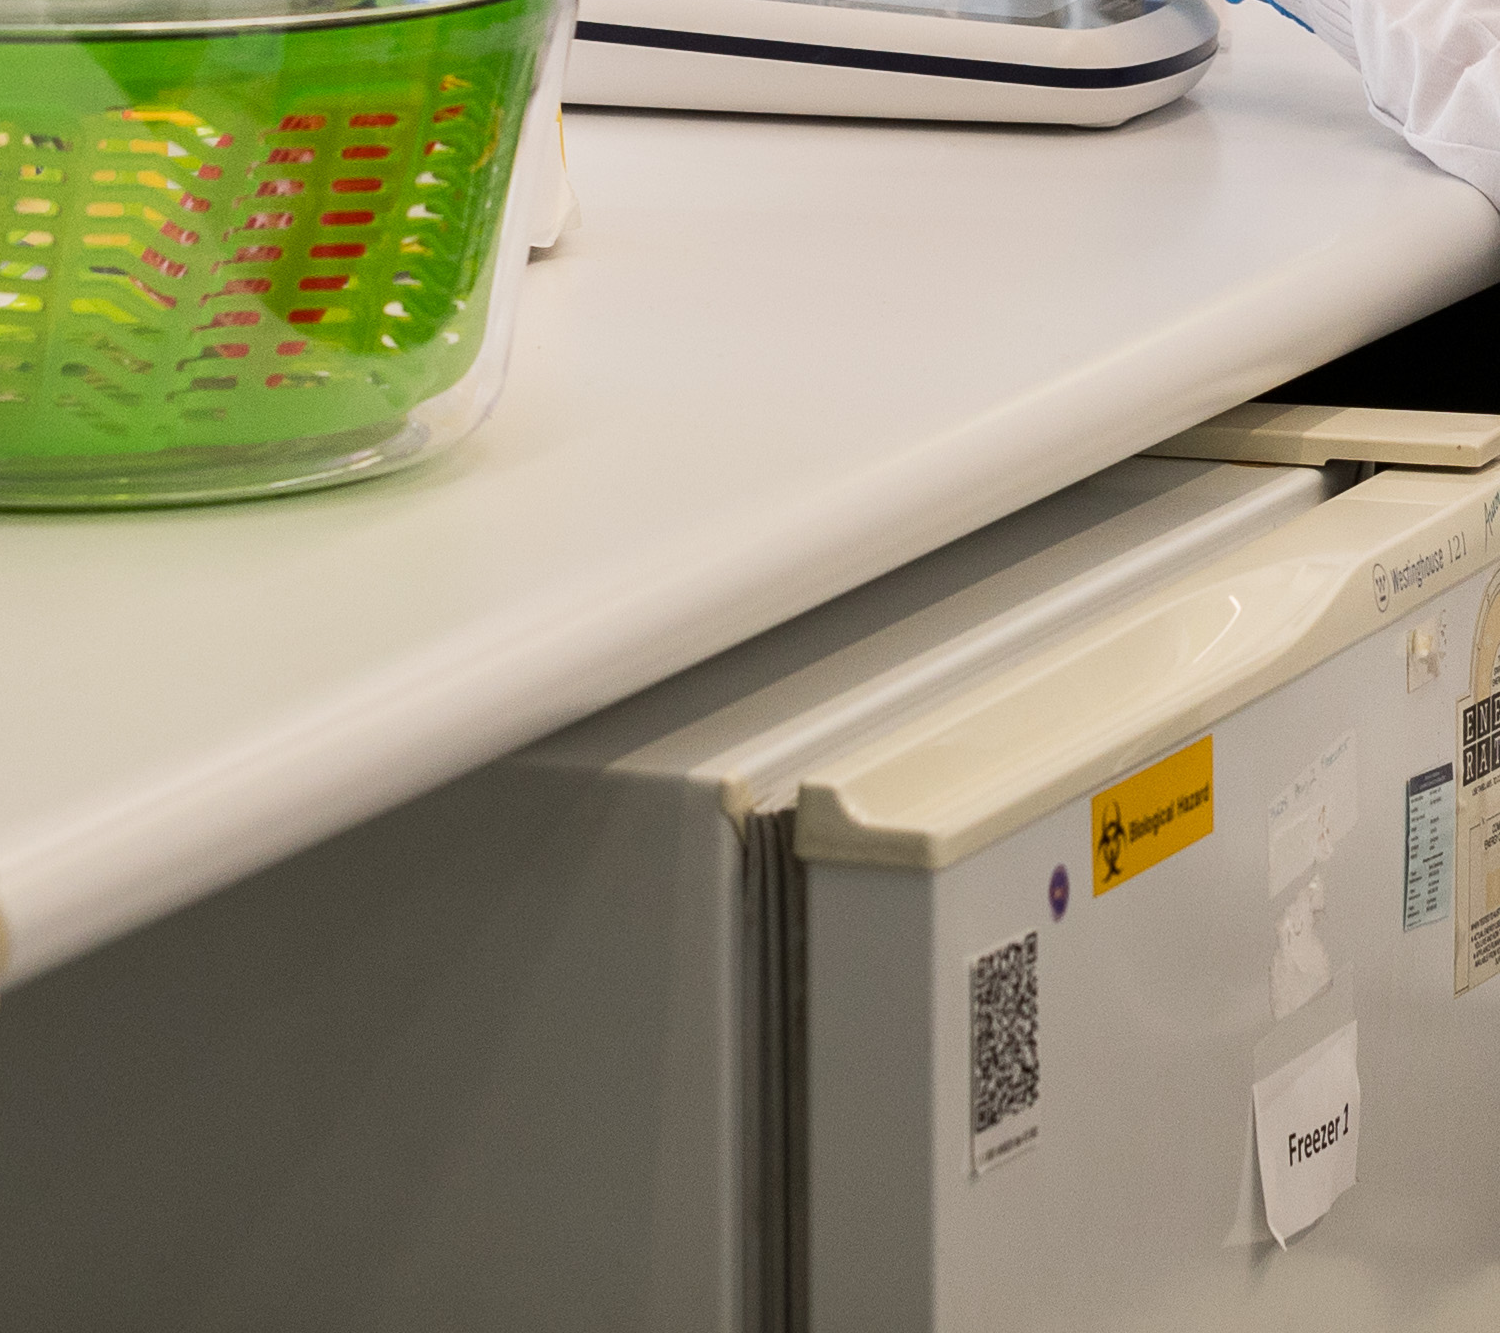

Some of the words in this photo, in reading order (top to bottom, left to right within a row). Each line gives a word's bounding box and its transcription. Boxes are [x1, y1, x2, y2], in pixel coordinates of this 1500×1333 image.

[1390, 547, 1445, 595] Westinghouse
[1447, 531, 1468, 564] 121
[1176, 781, 1210, 817] Hazard
[1287, 1114, 1342, 1167] Freezer
[1341, 1102, 1351, 1136] 1
